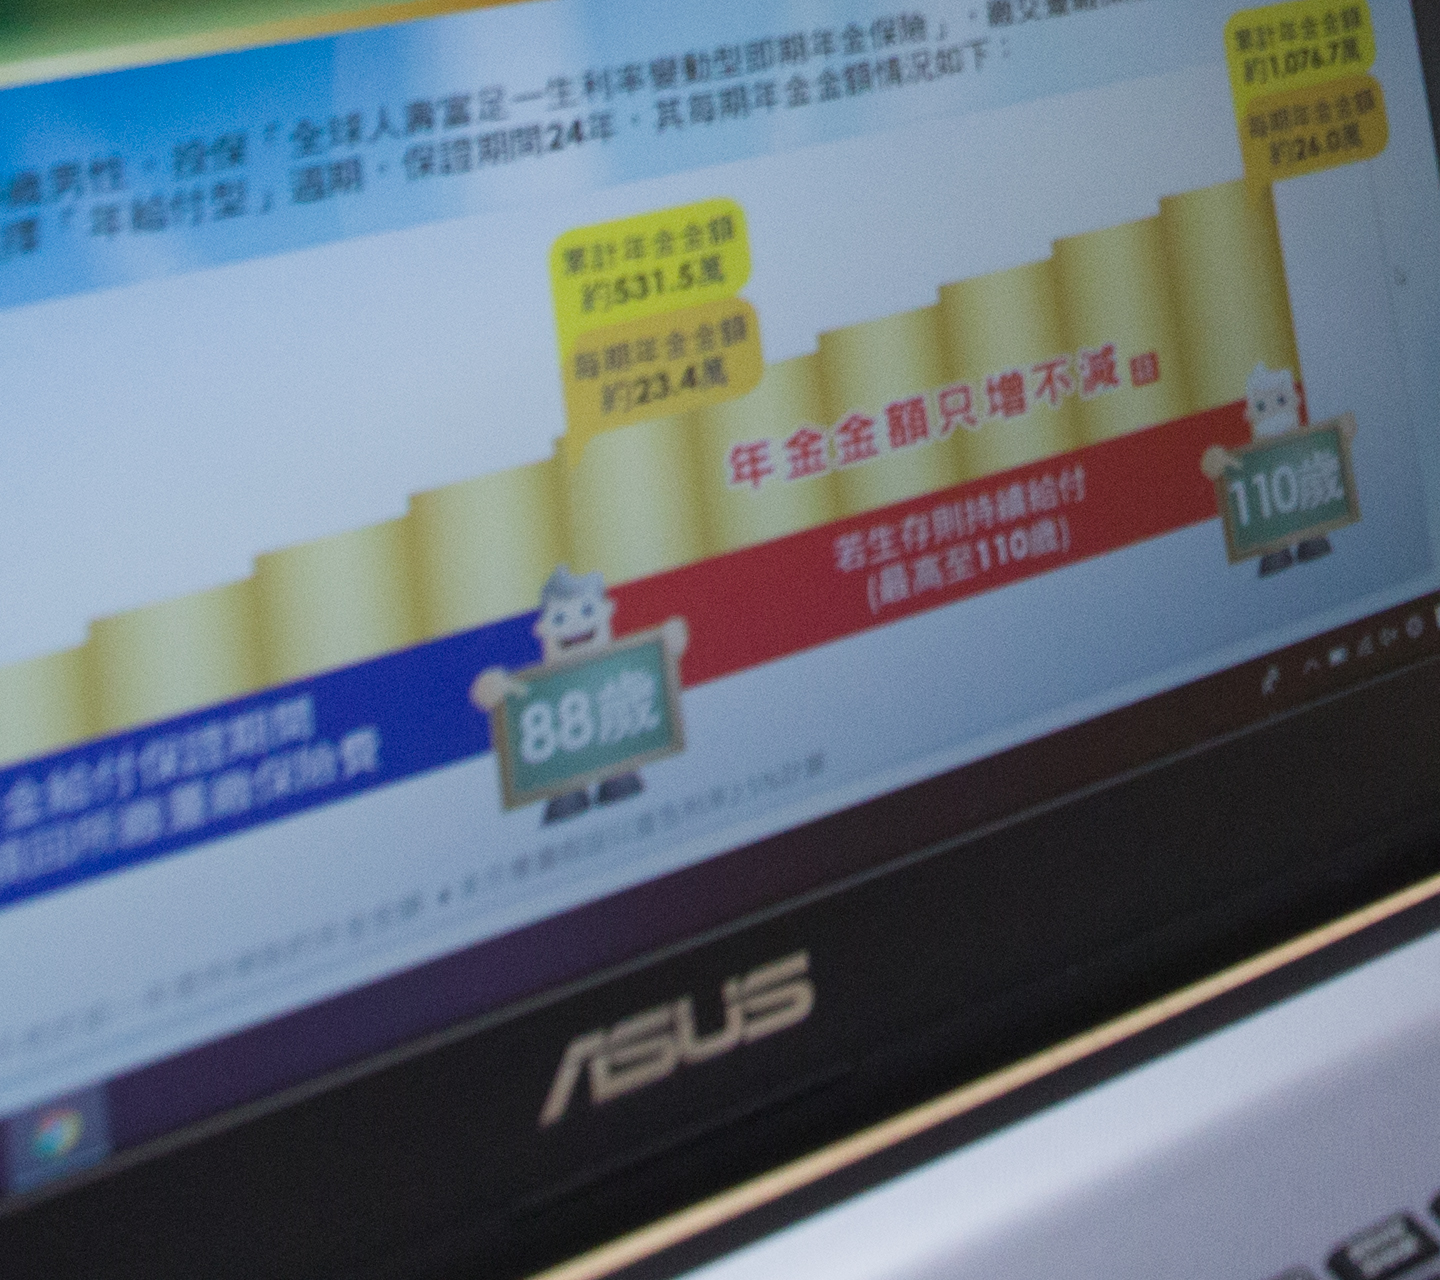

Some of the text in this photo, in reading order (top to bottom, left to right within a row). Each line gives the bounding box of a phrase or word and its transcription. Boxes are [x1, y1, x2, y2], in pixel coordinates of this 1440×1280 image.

[1235, 6, 1361, 52] 累計年金金額
[1249, 89, 1376, 139] 每期年金金額
[562, 215, 734, 276] 累計年金金額
[581, 253, 725, 315] 約531.5萬
[574, 315, 748, 382] 每期年金金額
[601, 355, 728, 417] 約23.4萬
[727, 343, 1120, 492] 年金金額只增不減
[833, 468, 1090, 577] 若生存則持續給付
[1228, 444, 1346, 533] 110歲
[866, 521, 1072, 614] (最高至110歲)
[517, 676, 664, 769] 88歲
[541, 954, 814, 1127] ASUS
